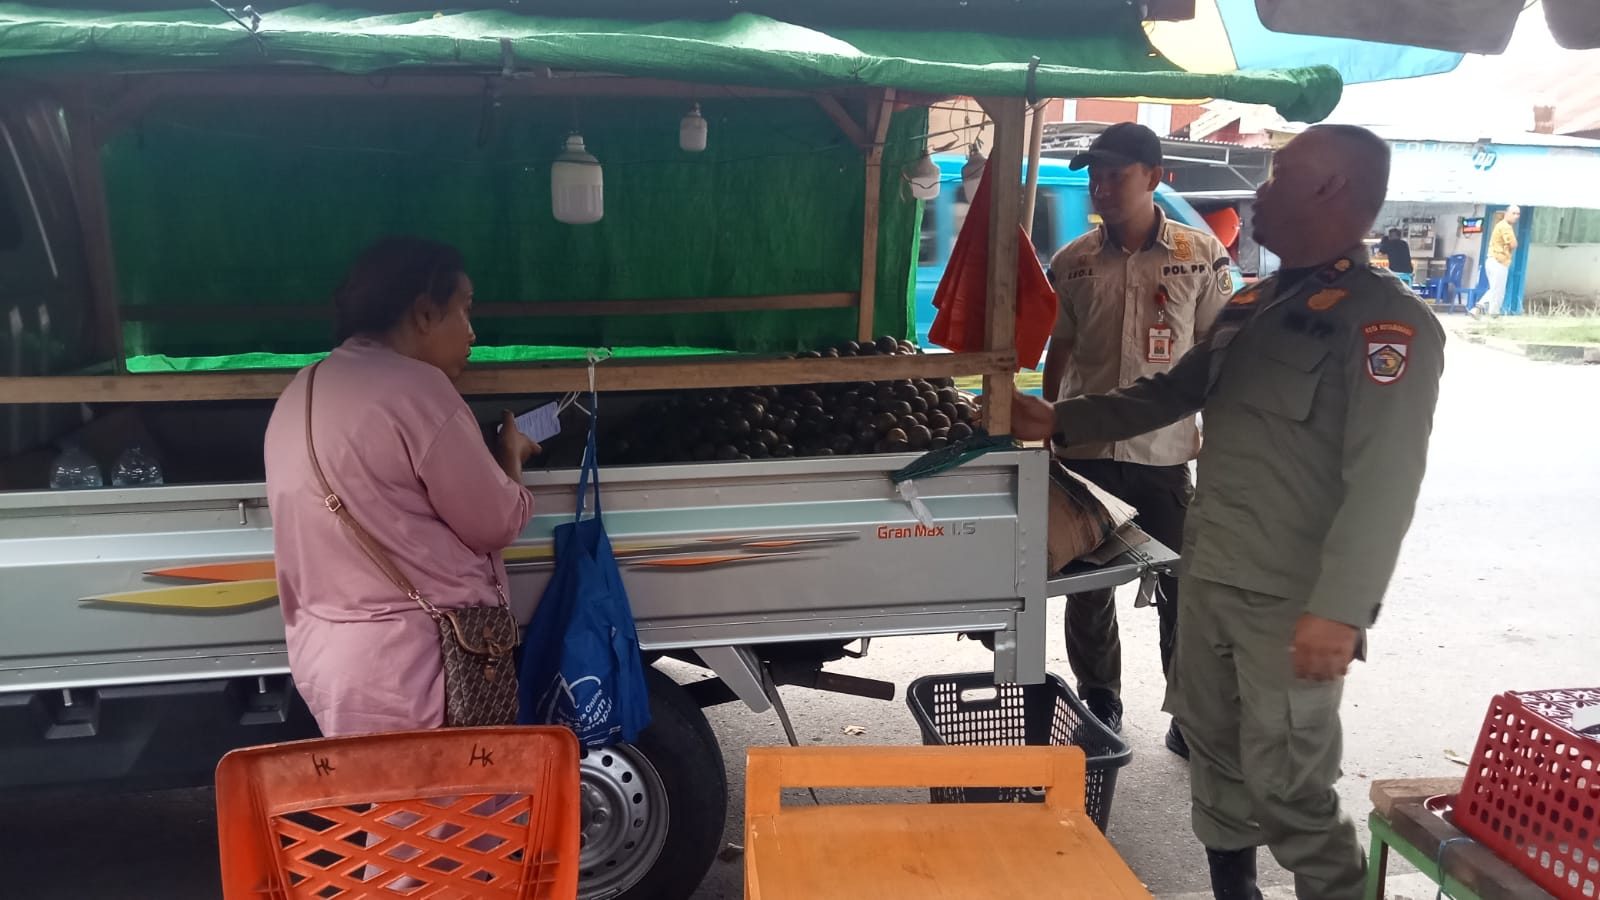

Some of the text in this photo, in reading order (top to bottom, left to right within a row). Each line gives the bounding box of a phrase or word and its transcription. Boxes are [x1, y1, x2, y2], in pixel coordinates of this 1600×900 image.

[1163, 263, 1206, 277] POL PP
[877, 525, 912, 540] Gran
[914, 524, 945, 538] Max
[585, 688, 603, 713] Online
